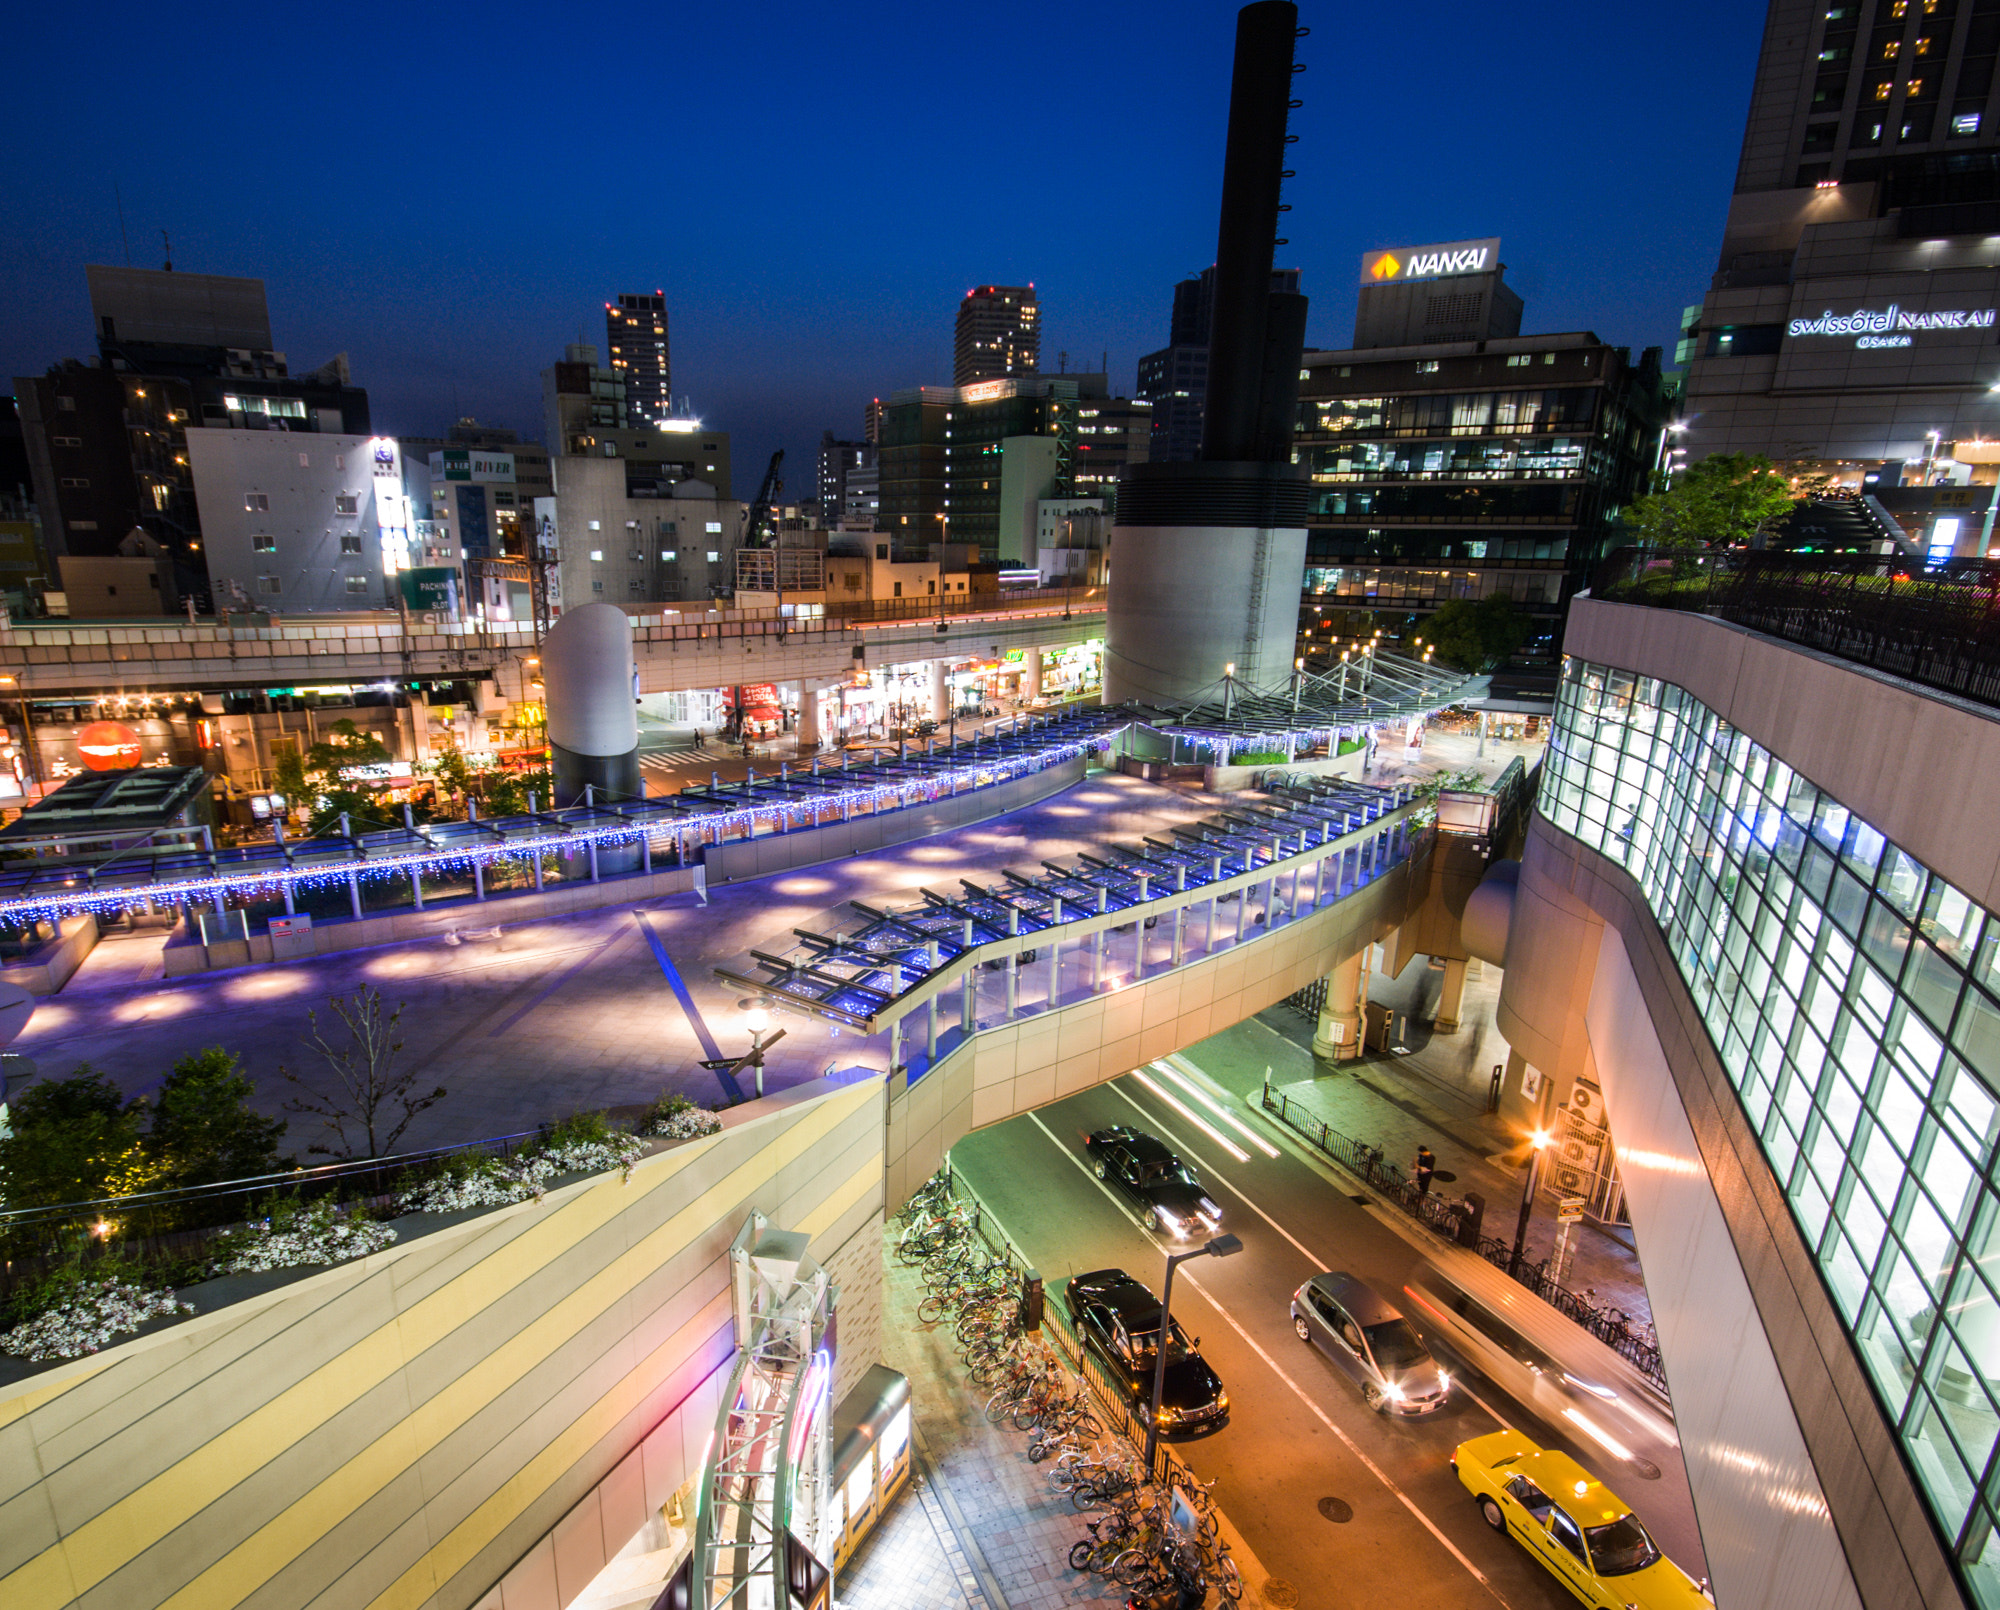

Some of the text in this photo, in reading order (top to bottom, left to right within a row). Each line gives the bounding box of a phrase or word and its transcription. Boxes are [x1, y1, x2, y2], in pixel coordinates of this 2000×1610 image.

[1406, 247, 1488, 277] NANKAI
[1788, 304, 1996, 336] swissôtel NANKAI
[1855, 334, 1912, 349] OSAKA
[474, 460, 510, 474] RIVER
[419, 581, 450, 591] PACHINK
[431, 600, 449, 610] SLOT
